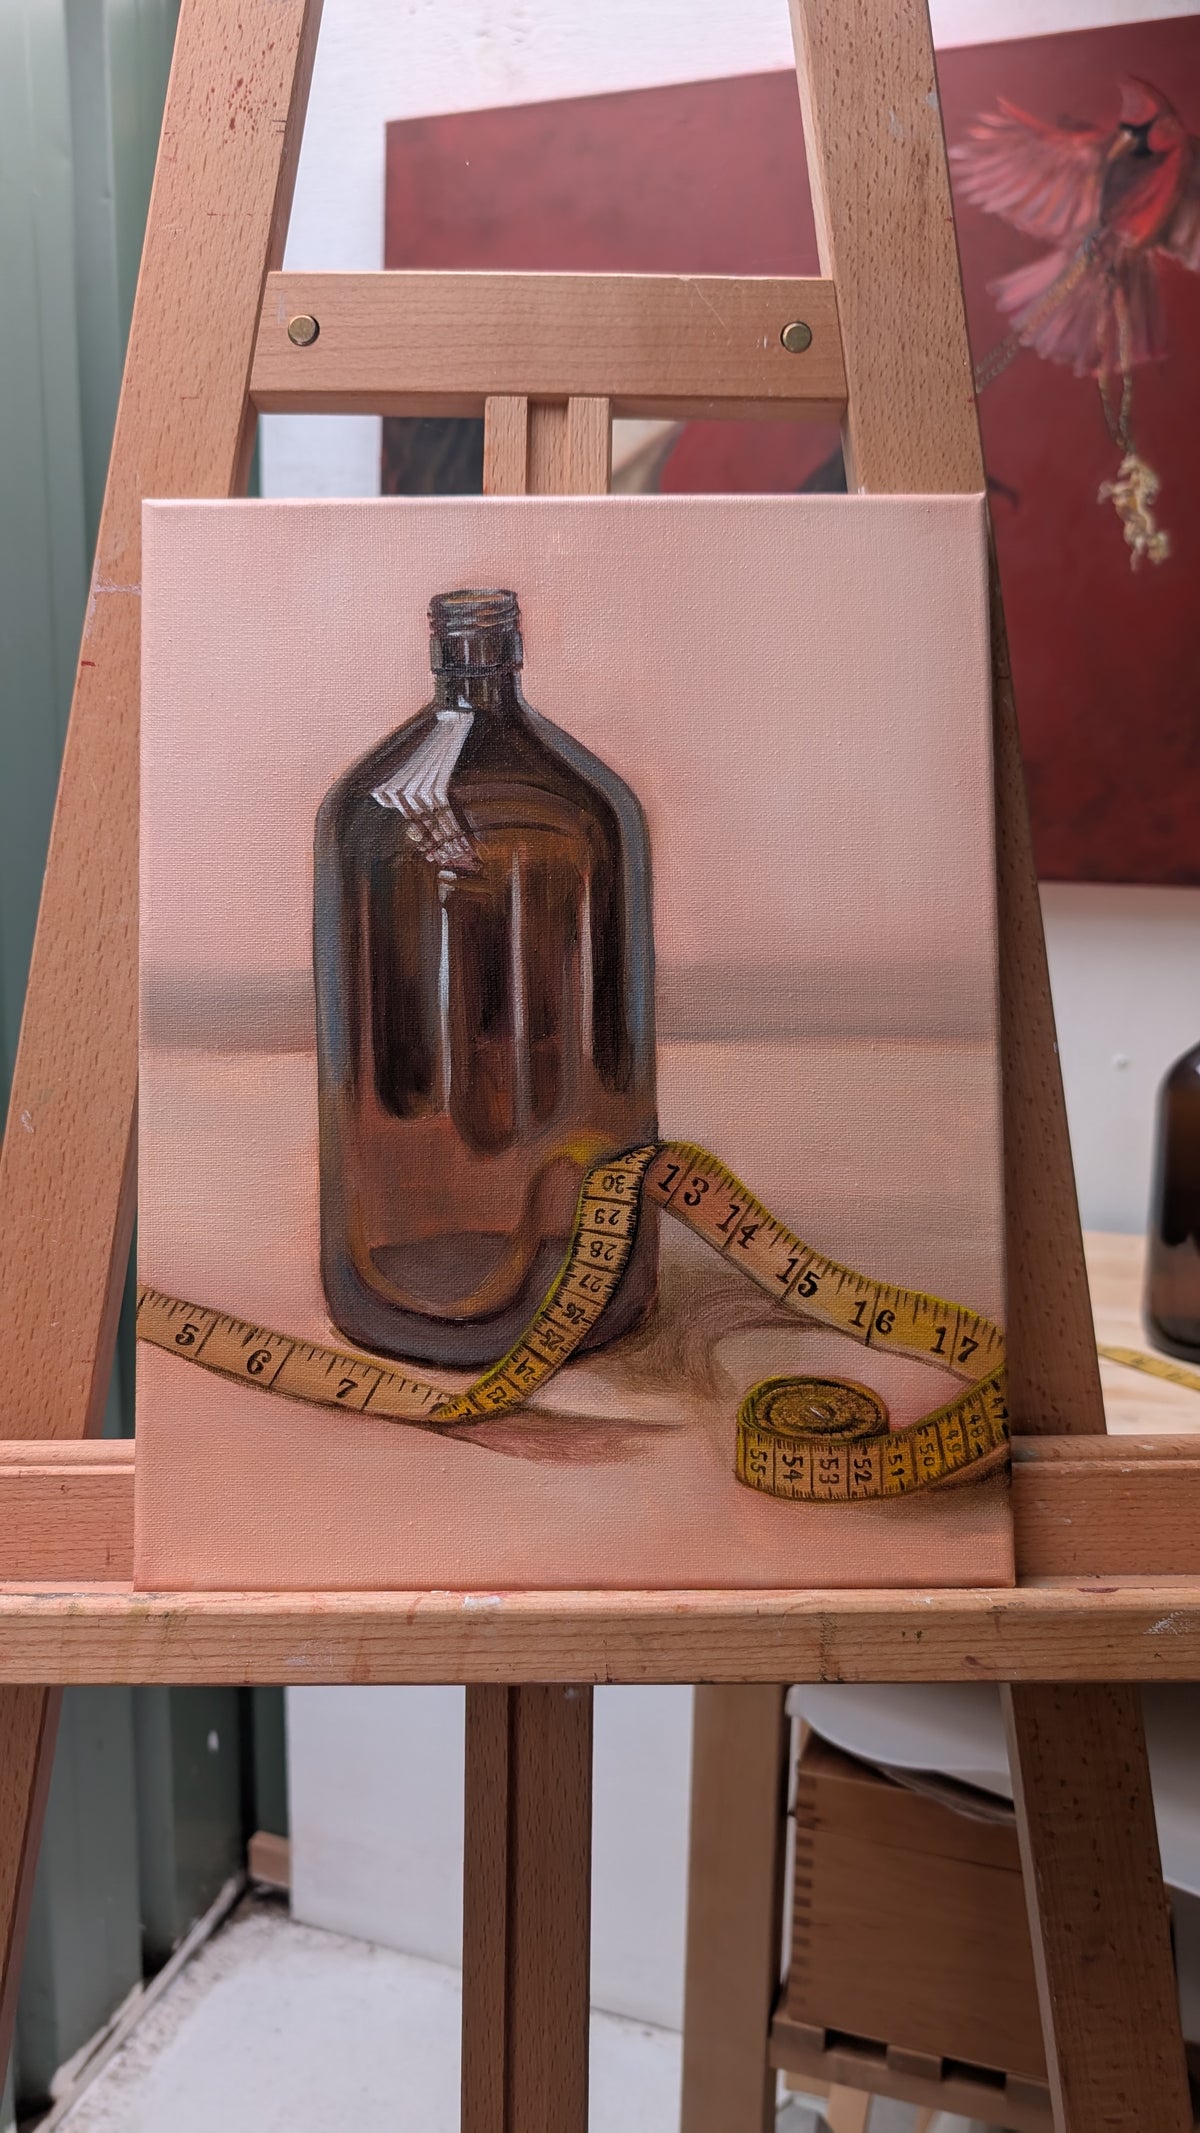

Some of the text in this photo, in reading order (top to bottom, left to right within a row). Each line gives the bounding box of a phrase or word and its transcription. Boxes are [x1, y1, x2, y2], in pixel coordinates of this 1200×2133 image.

[601, 1174, 626, 1195] 30
[658, 1163, 710, 1207] 13
[594, 1208, 621, 1226] 29
[715, 1203, 757, 1250] 14
[589, 1239, 617, 1261] 28
[578, 1272, 604, 1293] 27
[776, 1257, 821, 1298] 15
[563, 1302, 586, 1324] 26
[849, 1300, 896, 1336] 16
[175, 1323, 200, 1346] 5
[539, 1328, 565, 1350] 25
[930, 1325, 979, 1363] 17
[246, 1349, 273, 1375] 6
[514, 1357, 537, 1383] 24
[335, 1377, 359, 1399] 7
[968, 1414, 984, 1438] 48
[750, 1448, 768, 1476] 55
[782, 1453, 804, 1482] 54
[888, 1454, 905, 1477] 51
[919, 1443, 935, 1467] 50
[819, 1458, 840, 1485] 53
[854, 1457, 873, 1485] 52
